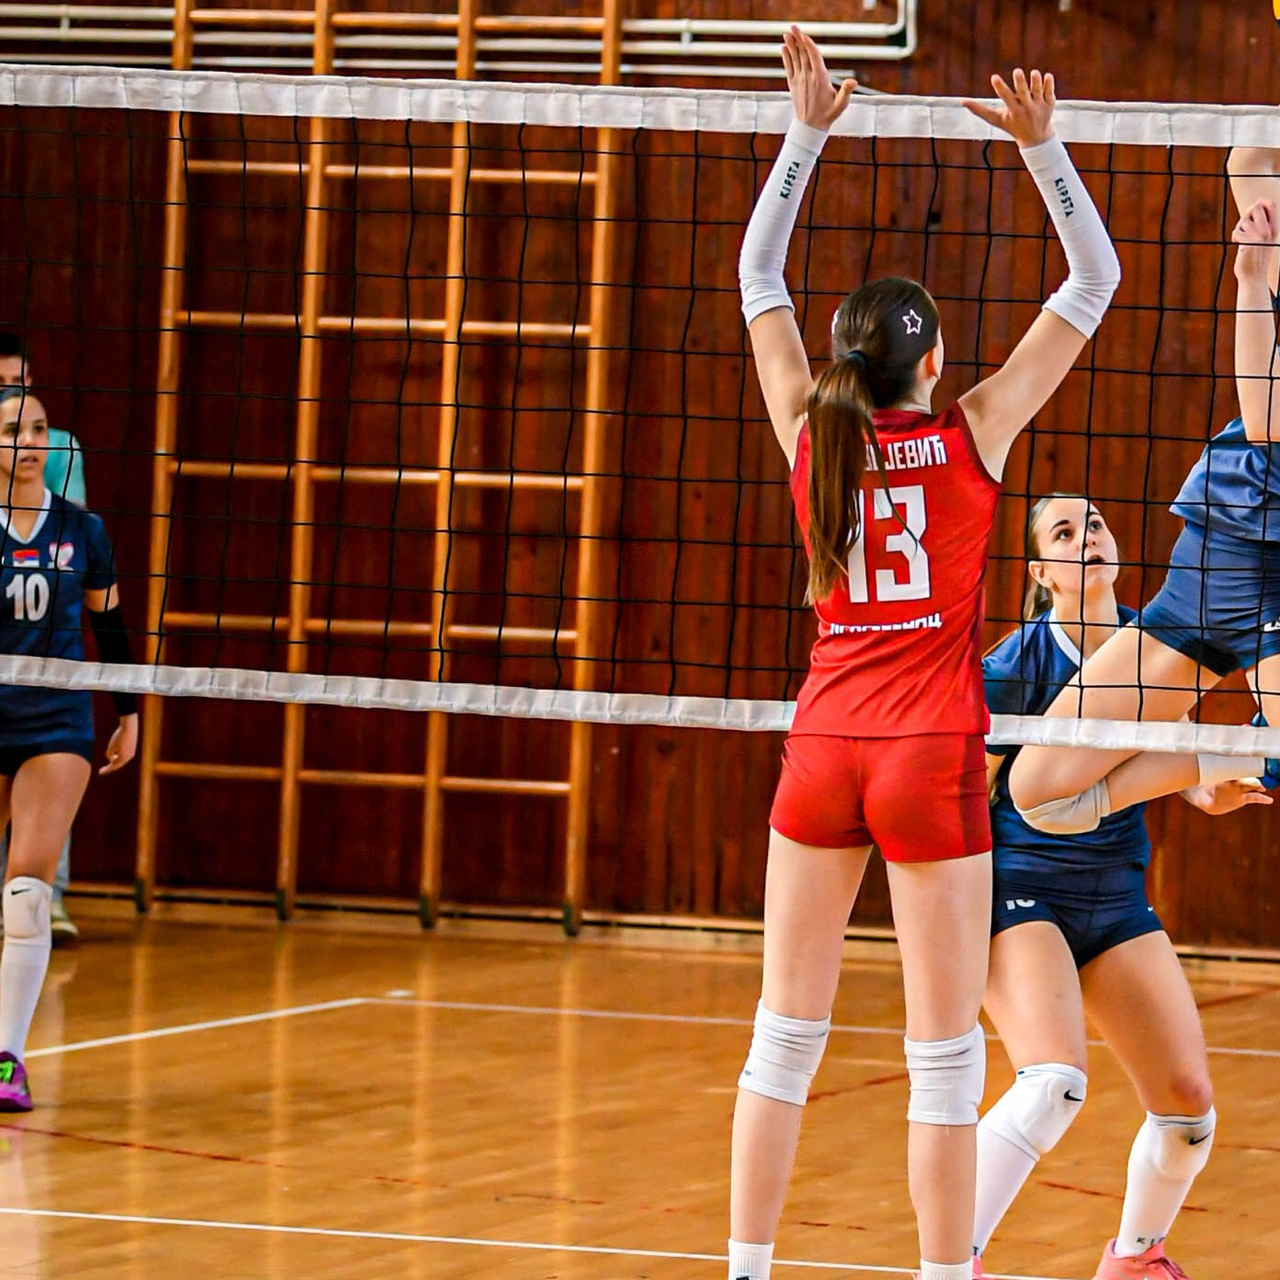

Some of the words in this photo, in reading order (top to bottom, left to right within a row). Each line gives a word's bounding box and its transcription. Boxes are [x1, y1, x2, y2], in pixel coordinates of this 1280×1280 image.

[780, 161, 801, 200] KIPSTA
[1054, 177, 1074, 218] KIPSTA
[847, 485, 931, 603] 13
[6, 572, 50, 622] 10
